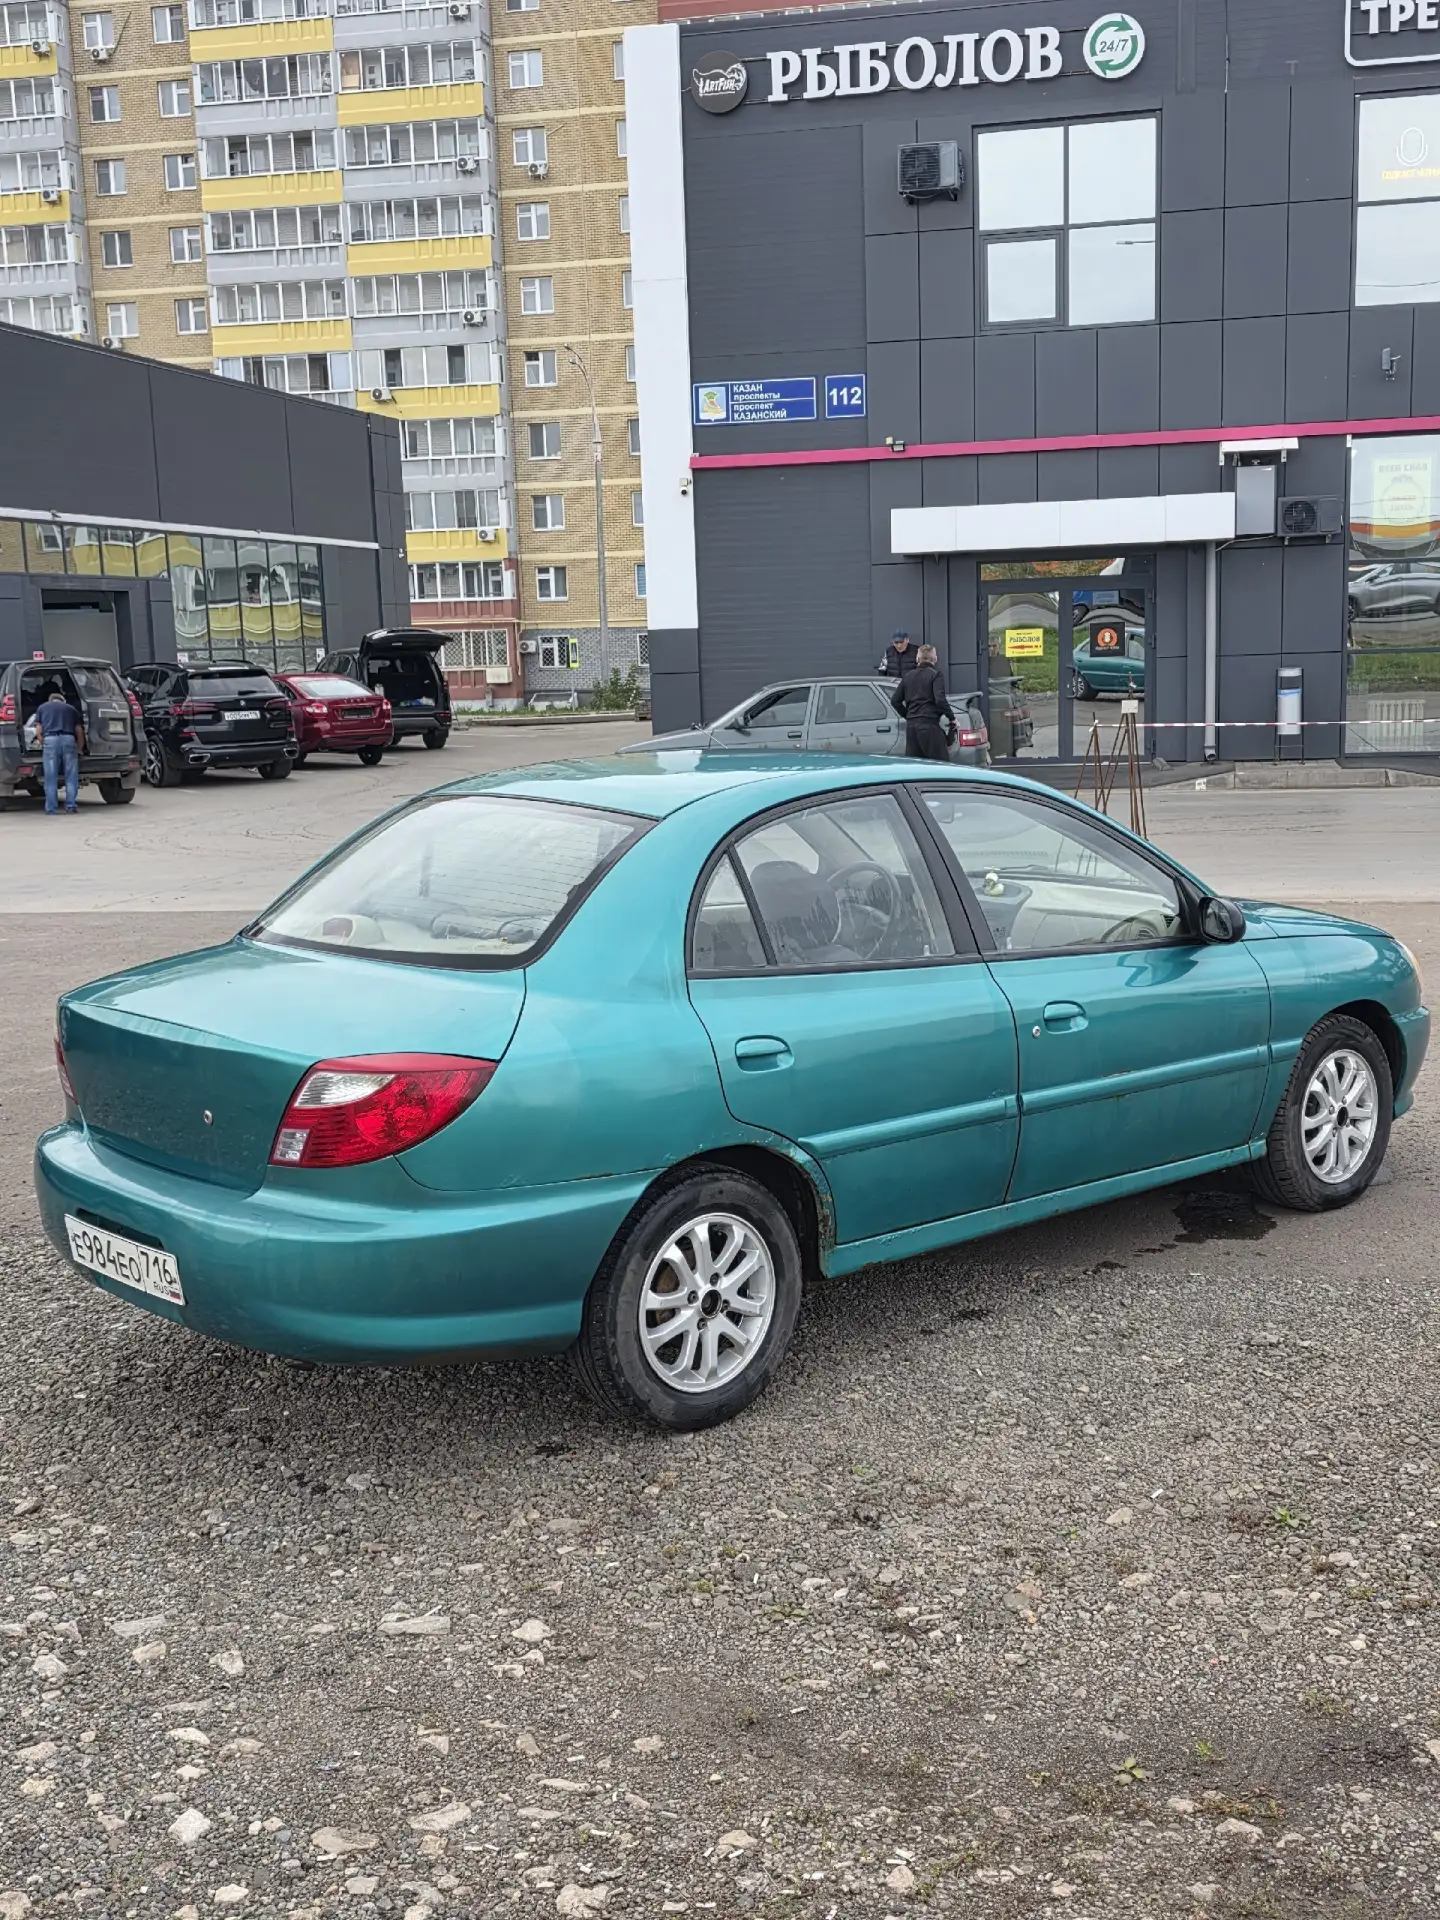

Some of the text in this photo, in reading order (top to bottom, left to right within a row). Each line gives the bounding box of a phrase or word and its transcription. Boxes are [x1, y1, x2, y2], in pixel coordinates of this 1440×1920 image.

[1099, 38, 1129, 53] 24/7
[766, 25, 1063, 102] РЫБОЛОВ
[733, 384, 763, 393] КАЗАН
[733, 392, 781, 401] проспекты
[829, 387, 862, 406] 112
[733, 403, 774, 412] проспект
[733, 409, 787, 421] КАЗАНСКИЙ
[153, 1281, 170, 1296] RUS
